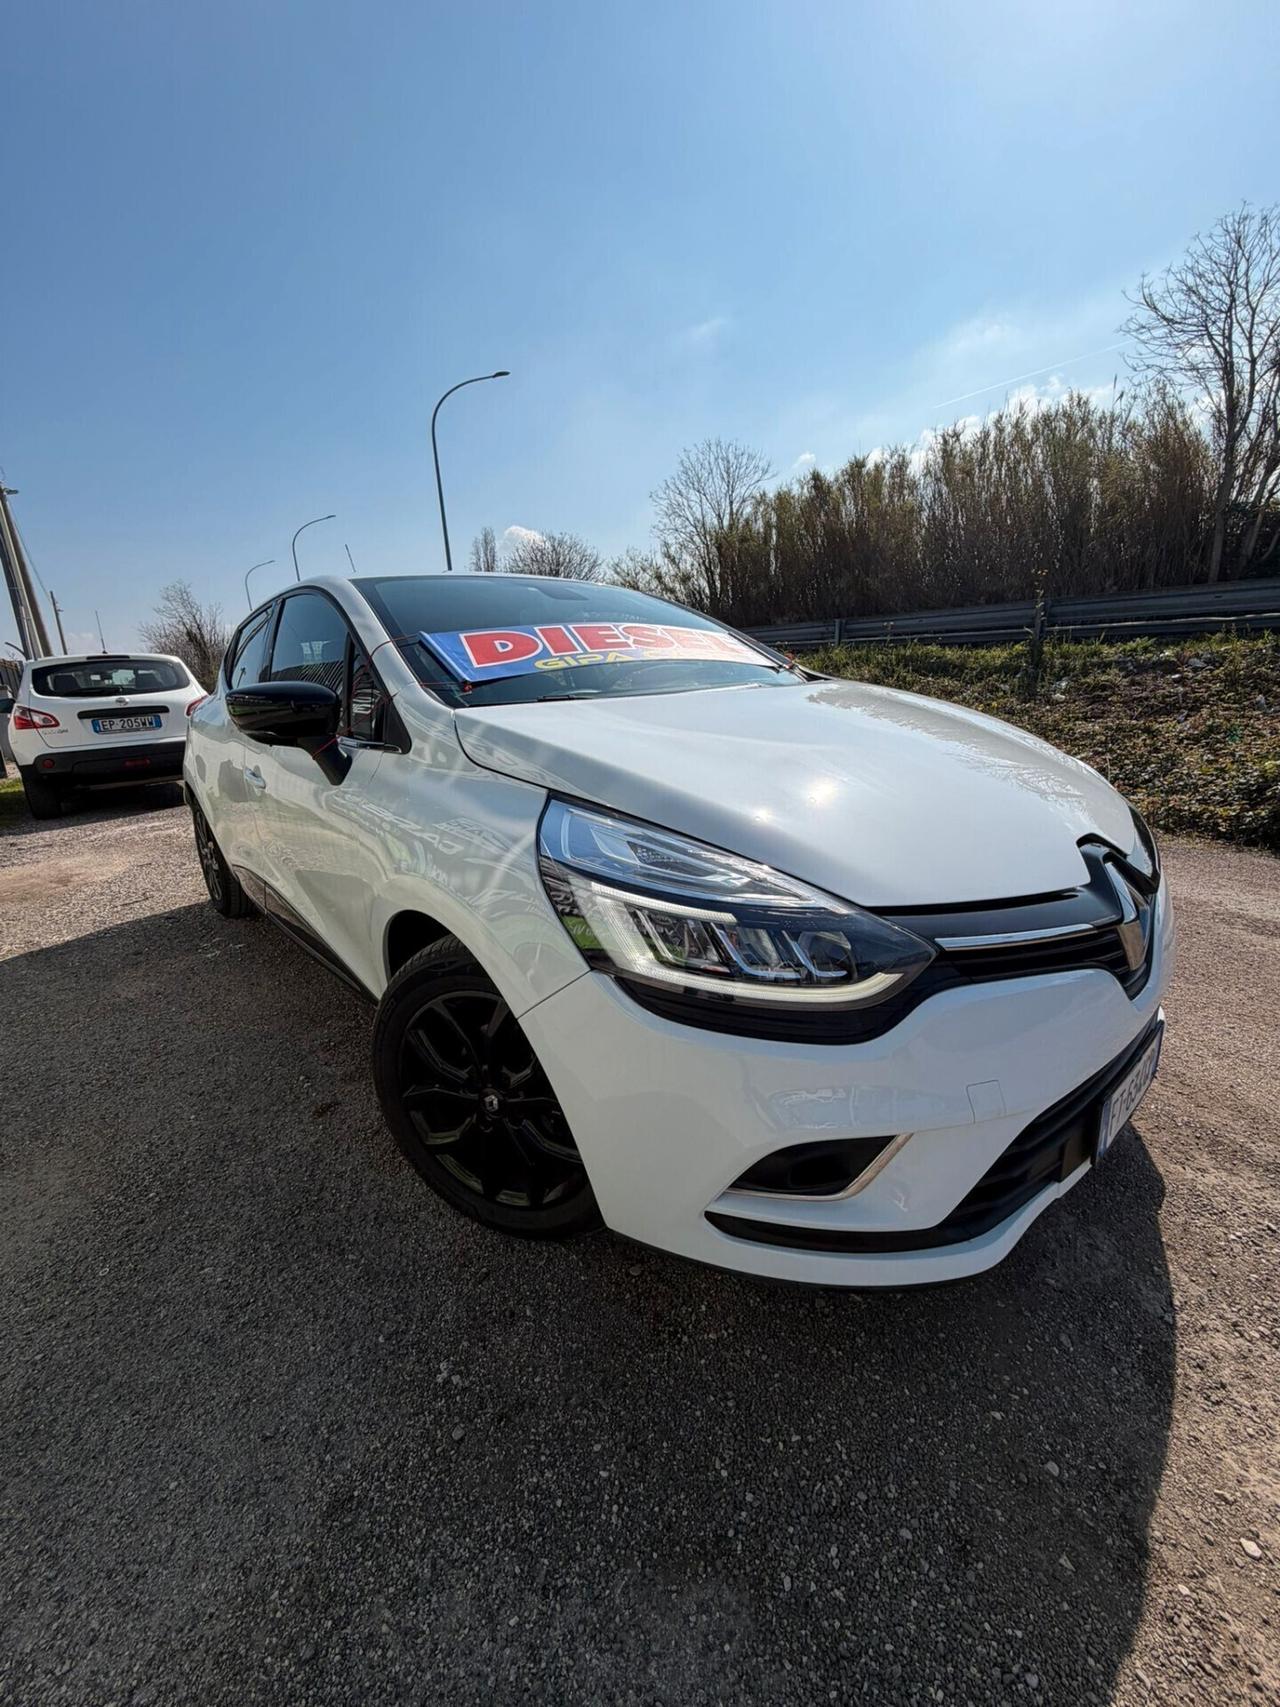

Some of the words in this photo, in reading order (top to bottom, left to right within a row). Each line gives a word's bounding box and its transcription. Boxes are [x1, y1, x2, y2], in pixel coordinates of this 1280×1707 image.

[459, 622, 749, 668] DIESEL
[534, 651, 634, 670] GIPA
[101, 719, 115, 731] EP
